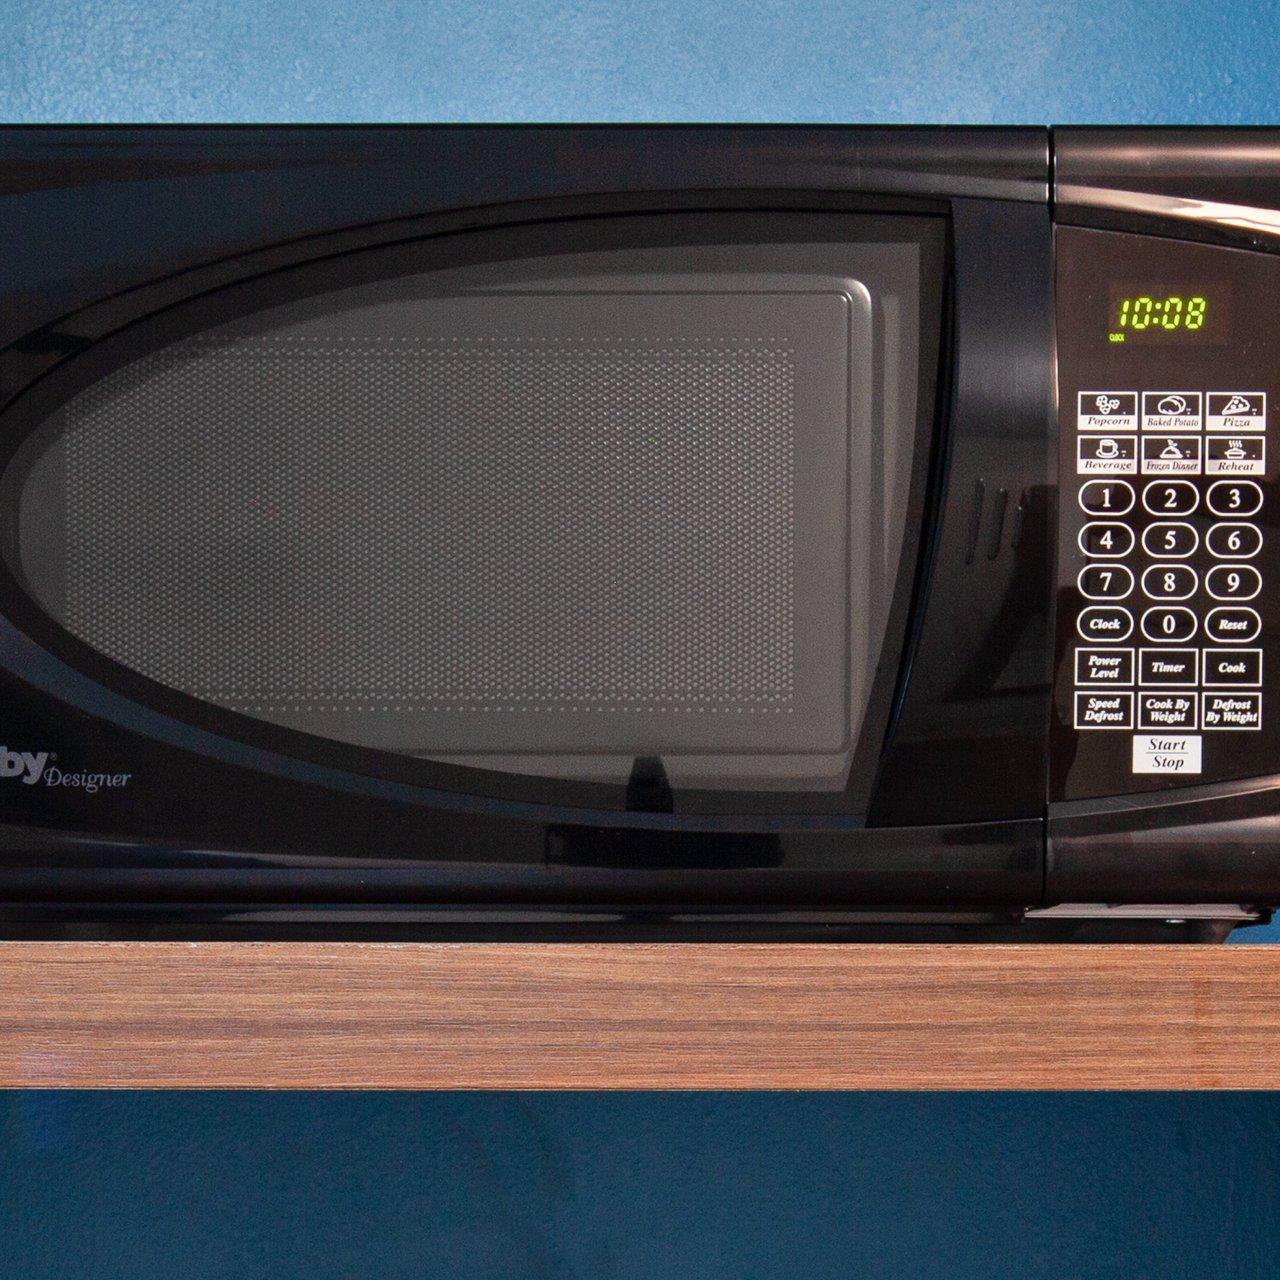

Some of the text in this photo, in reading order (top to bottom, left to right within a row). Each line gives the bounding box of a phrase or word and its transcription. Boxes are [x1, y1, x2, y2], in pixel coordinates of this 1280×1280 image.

[1119, 297, 1206, 329] 10:08
[1087, 417, 1130, 426] Popcorn
[1147, 417, 1199, 427] Baked Potato
[1222, 418, 1251, 427] Pizza
[1085, 461, 1132, 471] Beverage
[1146, 461, 1199, 472] Frozen Dinner
[1218, 461, 1254, 471] Reheat
[1102, 488, 1111, 508] 1
[1164, 488, 1177, 508] 2
[1228, 488, 1241, 509] 3
[1099, 530, 1113, 550] 4
[1164, 530, 1176, 550] 5
[1227, 530, 1241, 551] 6
[1099, 572, 1113, 592] 7
[1163, 572, 1176, 592] 8
[1227, 573, 1240, 593] 9
[1089, 618, 1121, 630] Clock
[1162, 614, 1176, 634] 0
[1218, 619, 1249, 630] Reset
[1088, 655, 1122, 667] Power
[1090, 667, 1119, 679] Level
[1151, 662, 1186, 674] Timer
[1218, 662, 1246, 674] Cook
[1088, 698, 1120, 710] Speed
[1145, 698, 1190, 711] Cook By
[1212, 699, 1252, 711] Defrost
[1084, 710, 1124, 723] Defrost
[1150, 711, 1186, 724] Weight
[1206, 711, 1258, 725] By Weight
[1148, 737, 1187, 751] Start
[1152, 755, 1185, 771] Stop
[43, 766, 132, 793] Designer
